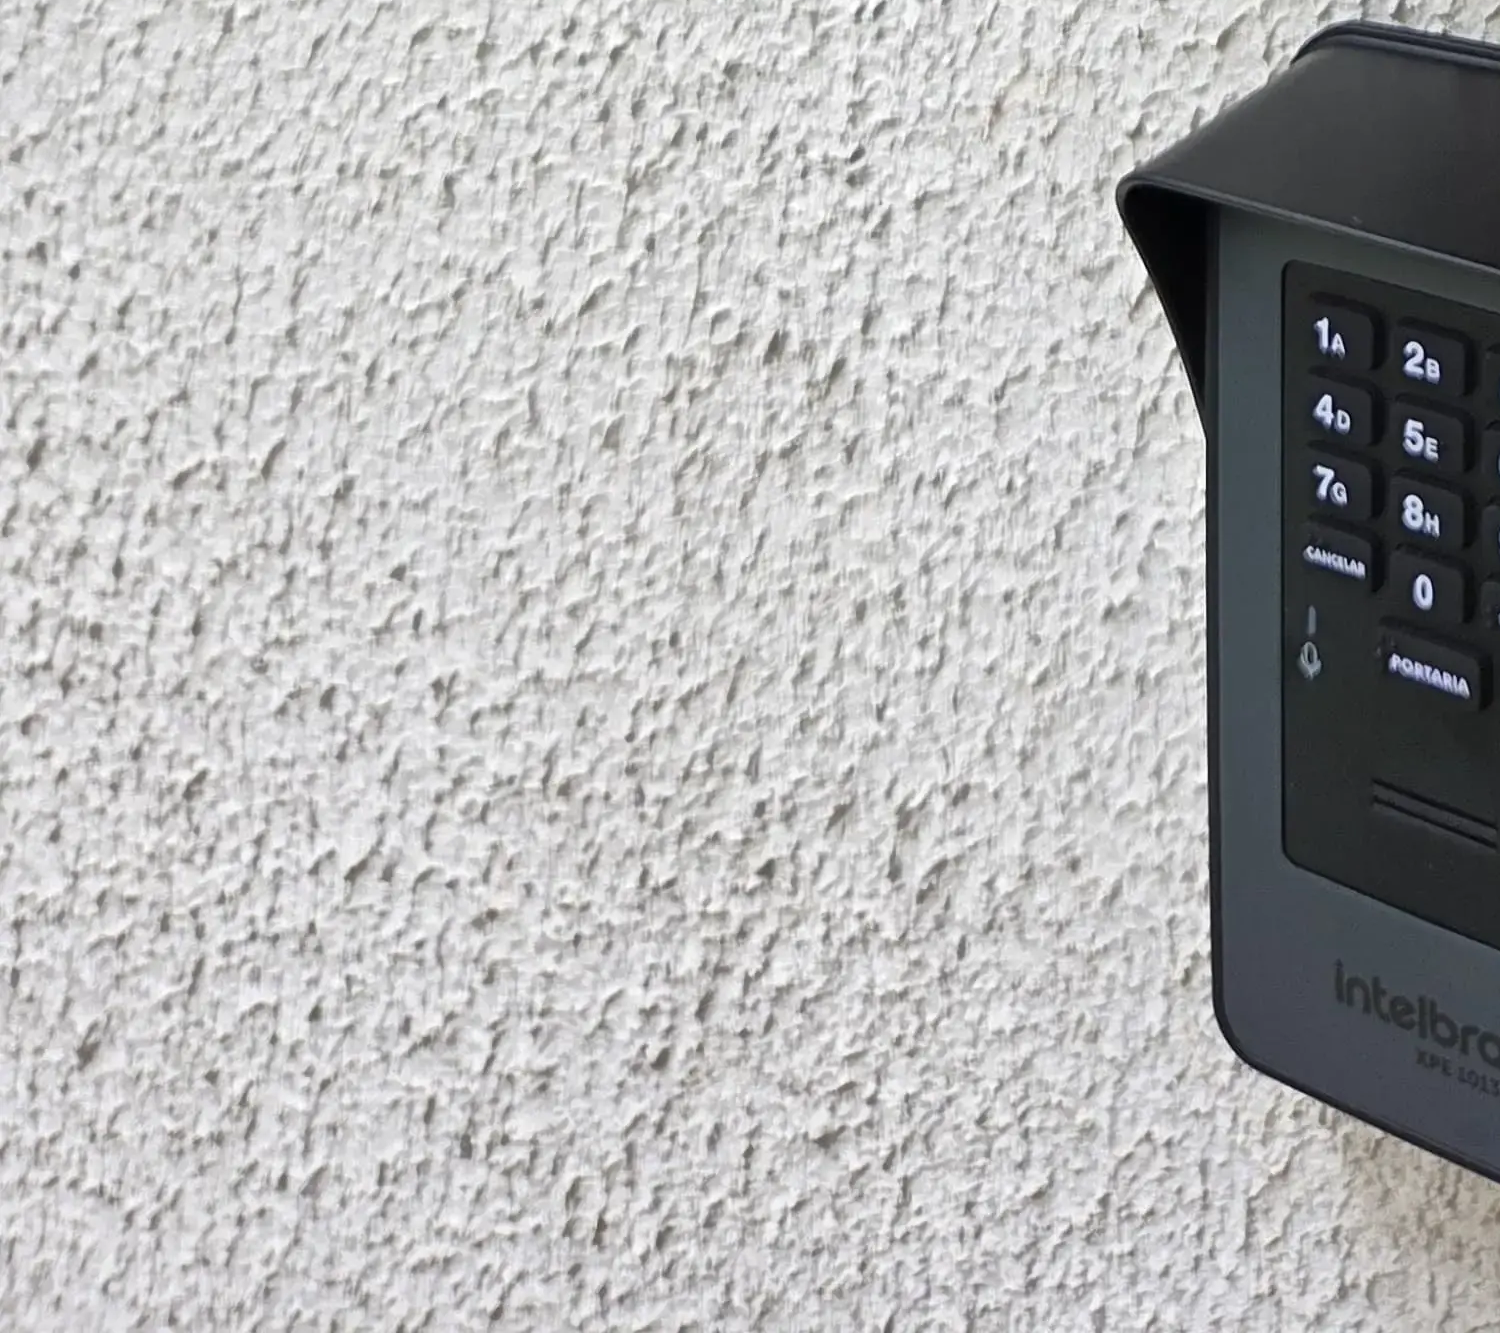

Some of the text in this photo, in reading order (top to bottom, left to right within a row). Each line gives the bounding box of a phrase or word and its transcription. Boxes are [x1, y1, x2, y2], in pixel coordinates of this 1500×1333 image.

[1303, 544, 1367, 579] CANCELAR
[1413, 573, 1434, 611] 0
[1389, 652, 1470, 699] PORTARIA
